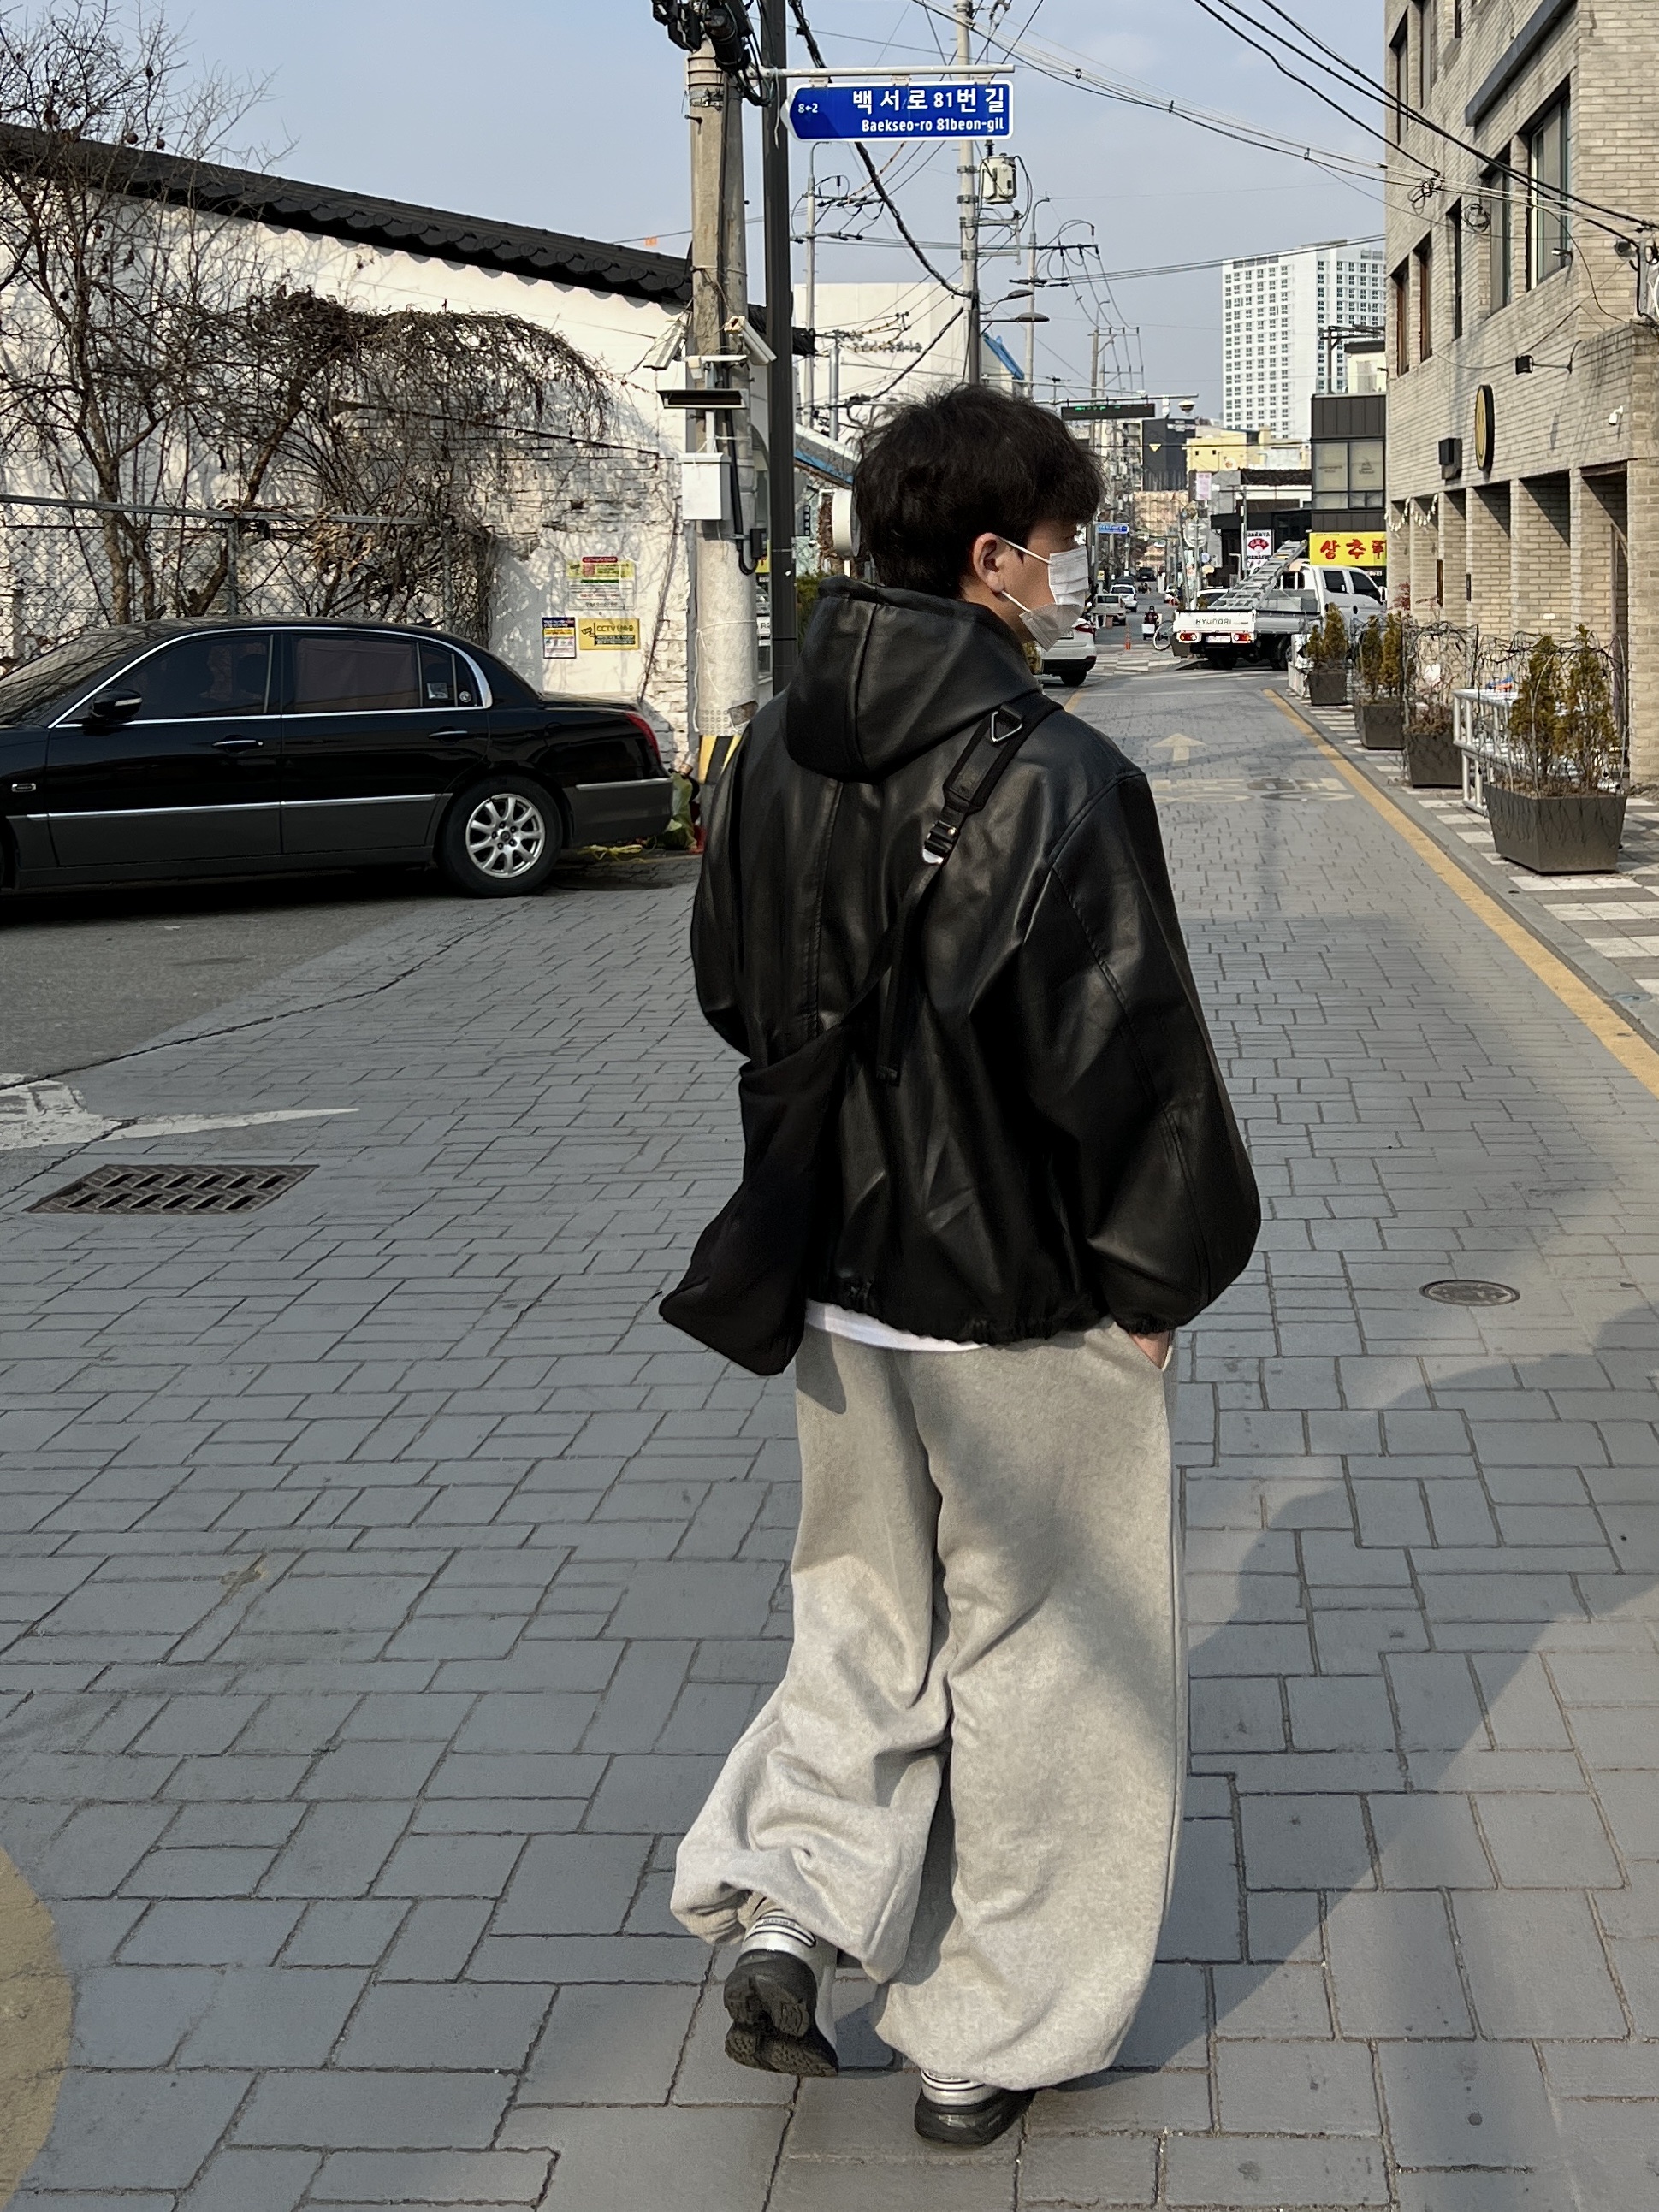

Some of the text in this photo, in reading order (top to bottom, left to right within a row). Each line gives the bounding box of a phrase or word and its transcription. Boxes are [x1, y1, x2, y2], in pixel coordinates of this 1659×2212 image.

[852, 87, 1004, 115] 백서로81번길
[862, 116, 1004, 133] Baekseo-ro 81beon-gil
